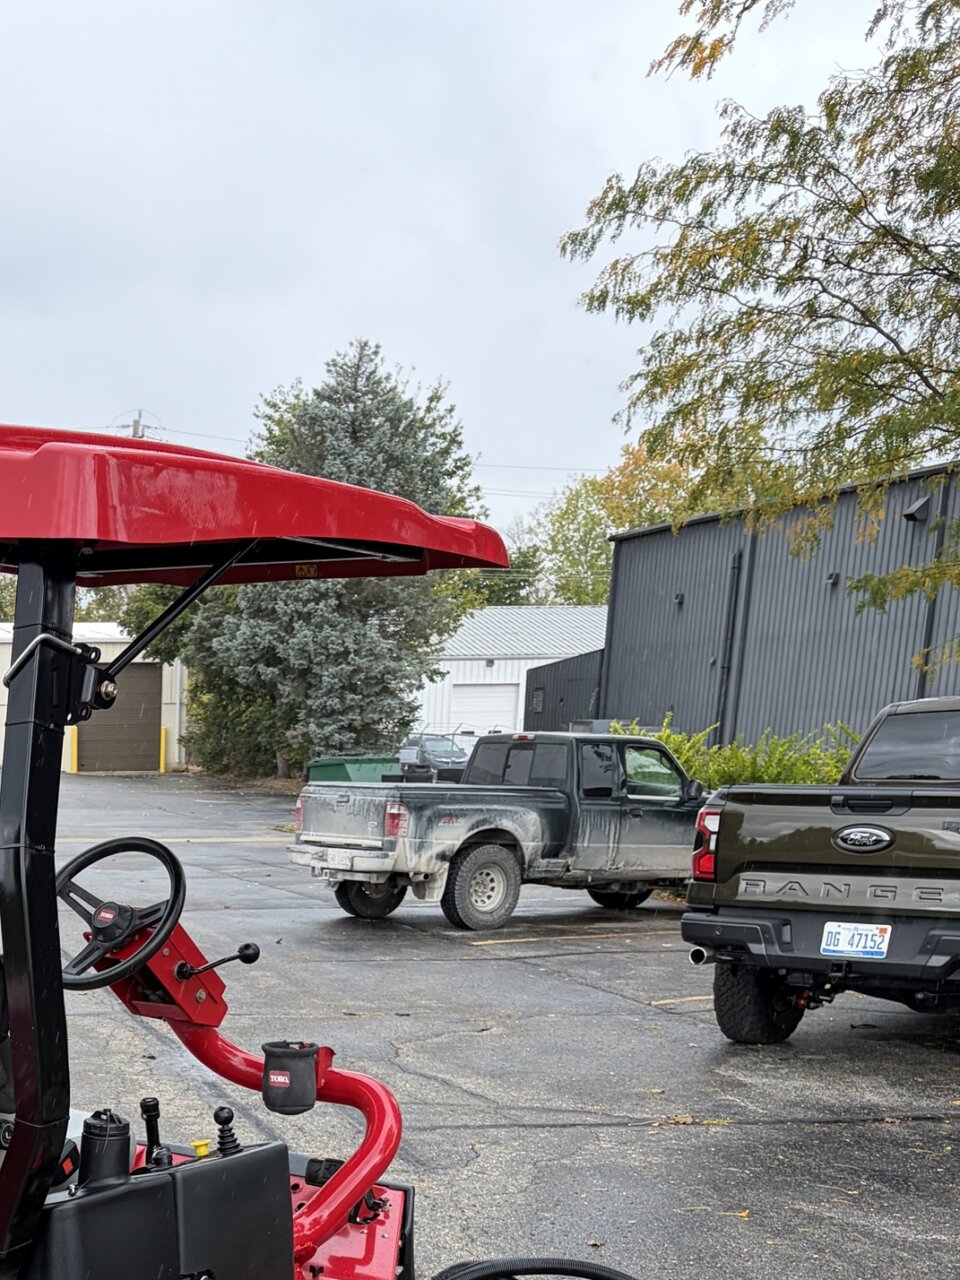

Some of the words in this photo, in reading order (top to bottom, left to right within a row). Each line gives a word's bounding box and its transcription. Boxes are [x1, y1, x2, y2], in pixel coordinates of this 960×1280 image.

[738, 878, 945, 904] RANGE
[825, 931, 841, 947] DG
[847, 932, 885, 950] 47152
